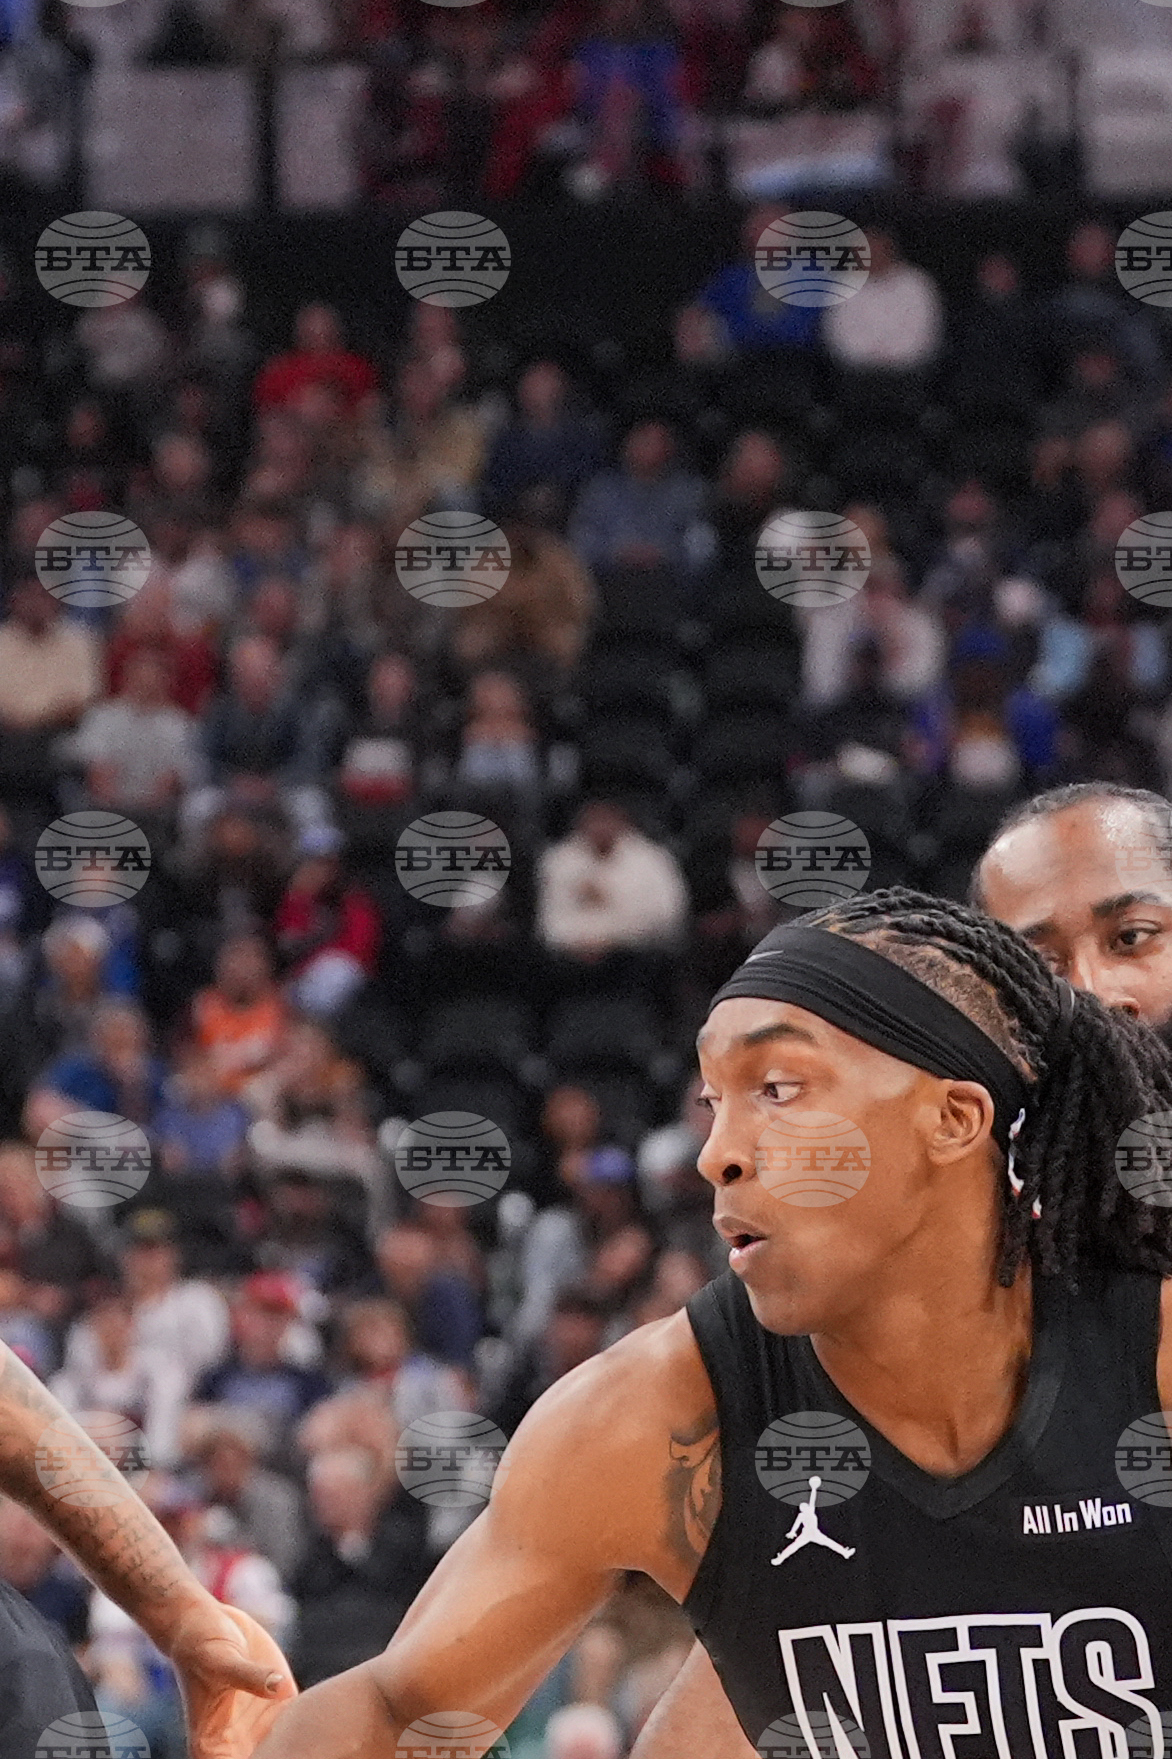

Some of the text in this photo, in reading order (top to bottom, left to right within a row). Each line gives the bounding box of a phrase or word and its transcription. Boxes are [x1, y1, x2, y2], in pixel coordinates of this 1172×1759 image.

[1023, 1497, 1132, 1535] All In Won
